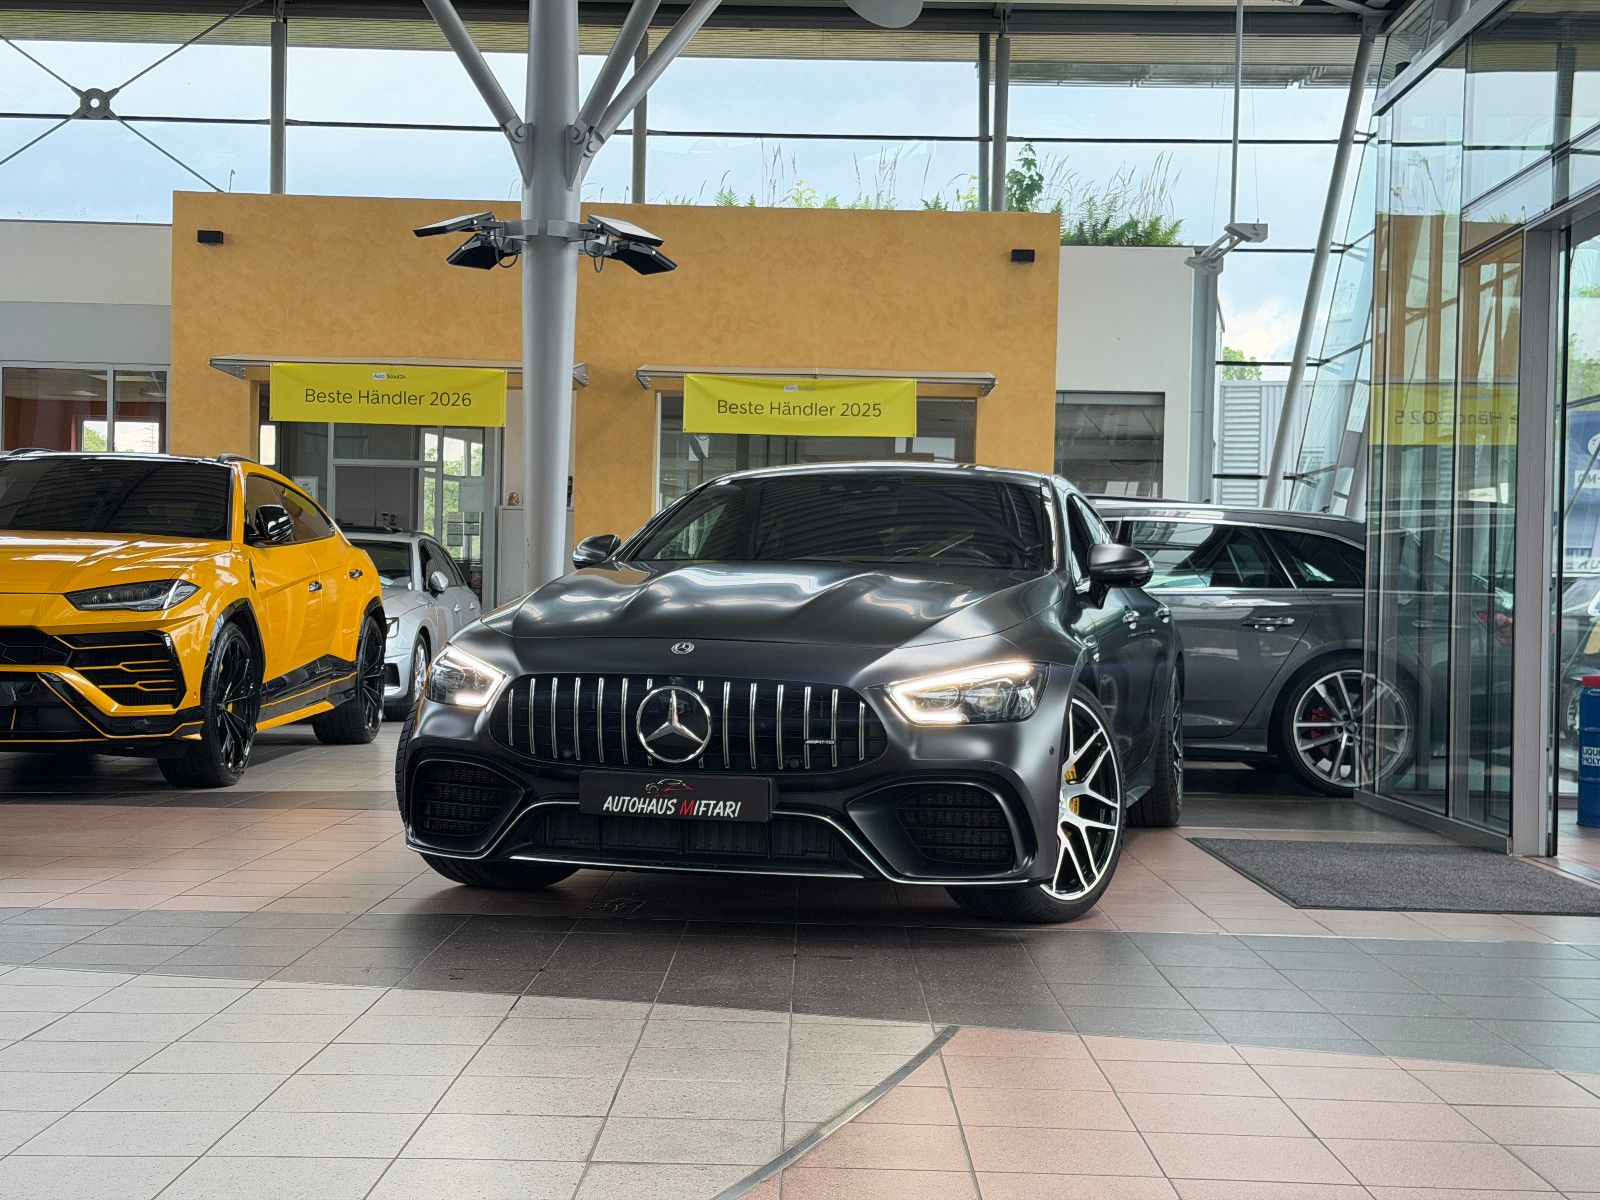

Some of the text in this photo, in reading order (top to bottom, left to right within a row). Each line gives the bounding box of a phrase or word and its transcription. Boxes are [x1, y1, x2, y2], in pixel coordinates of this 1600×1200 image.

[304, 388, 472, 407] Beste Händler 2026
[717, 399, 882, 418] Beste Händler 2025
[603, 795, 741, 819] AUTOHAUS MIFTARI
